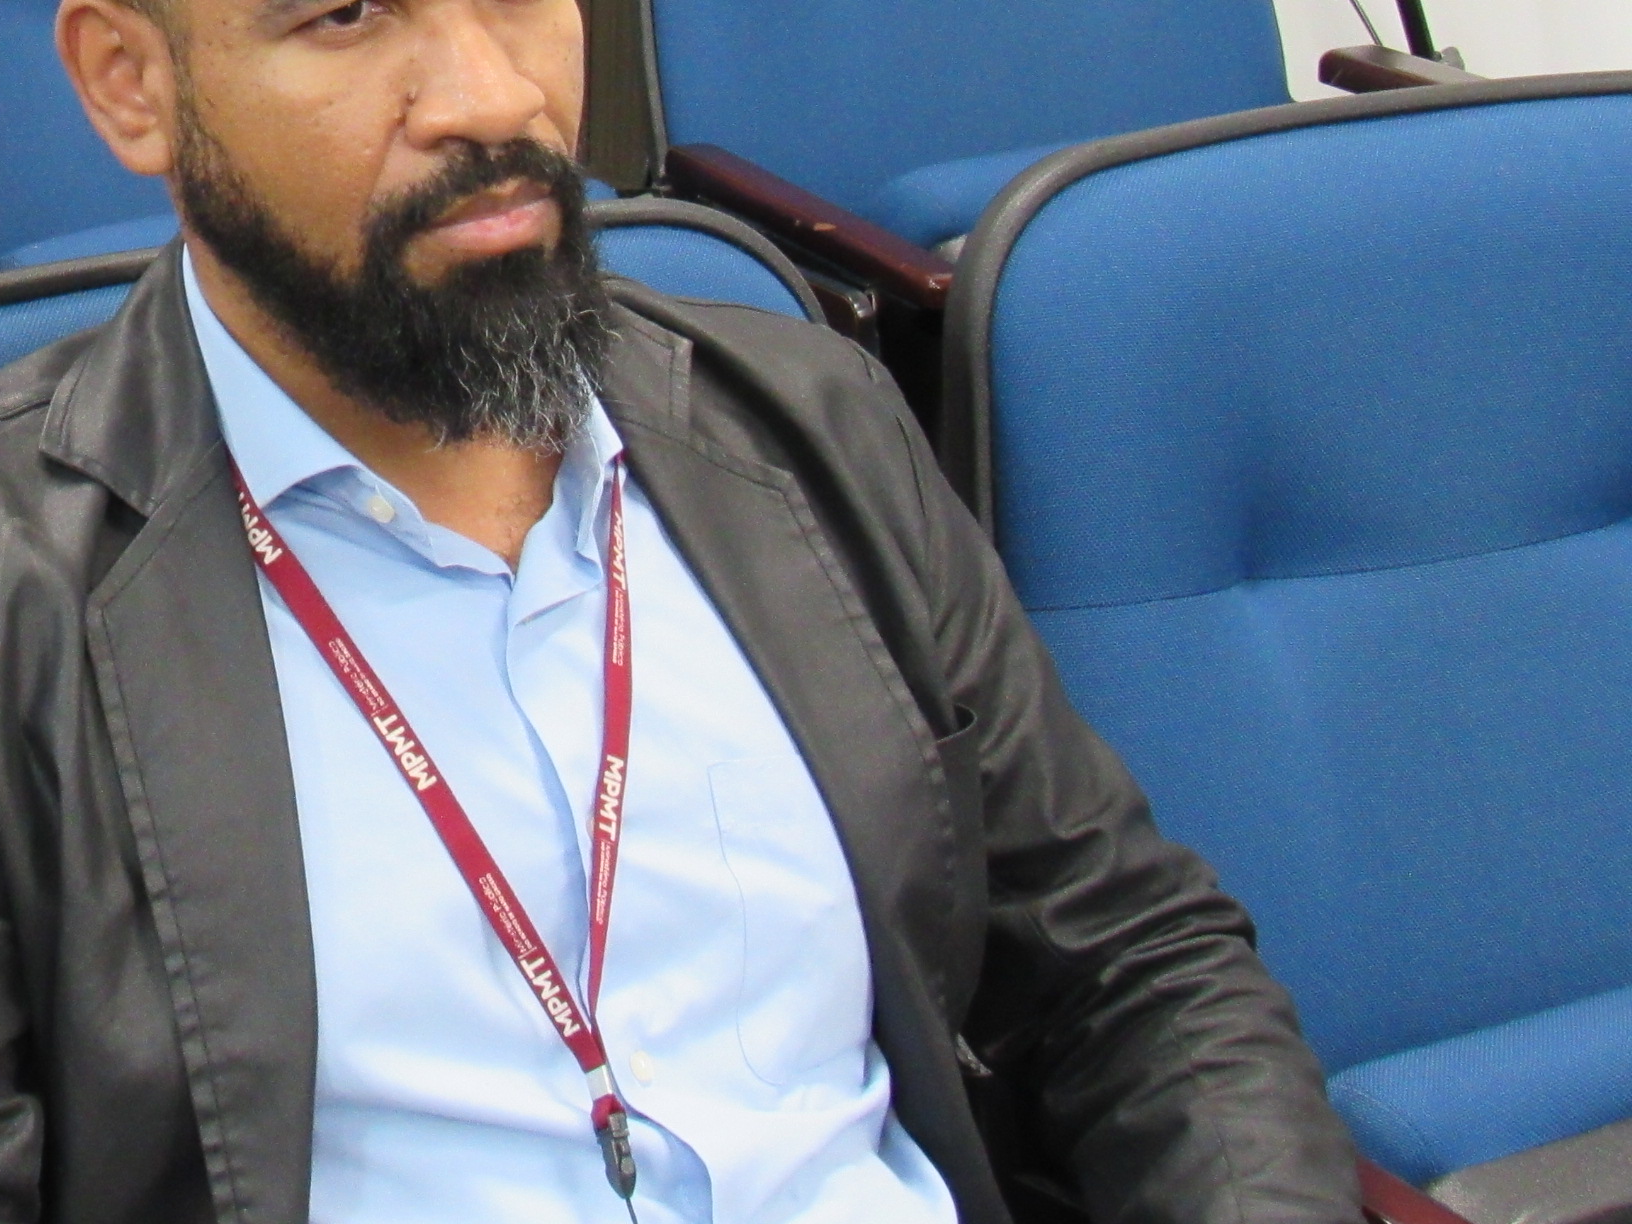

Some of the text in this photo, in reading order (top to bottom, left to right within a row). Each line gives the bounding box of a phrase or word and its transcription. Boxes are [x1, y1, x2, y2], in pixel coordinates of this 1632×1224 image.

[612, 512, 626, 591] MPMT
[374, 713, 438, 791] MPMT
[599, 754, 625, 842] MPMT
[520, 957, 581, 1038] MPMT
